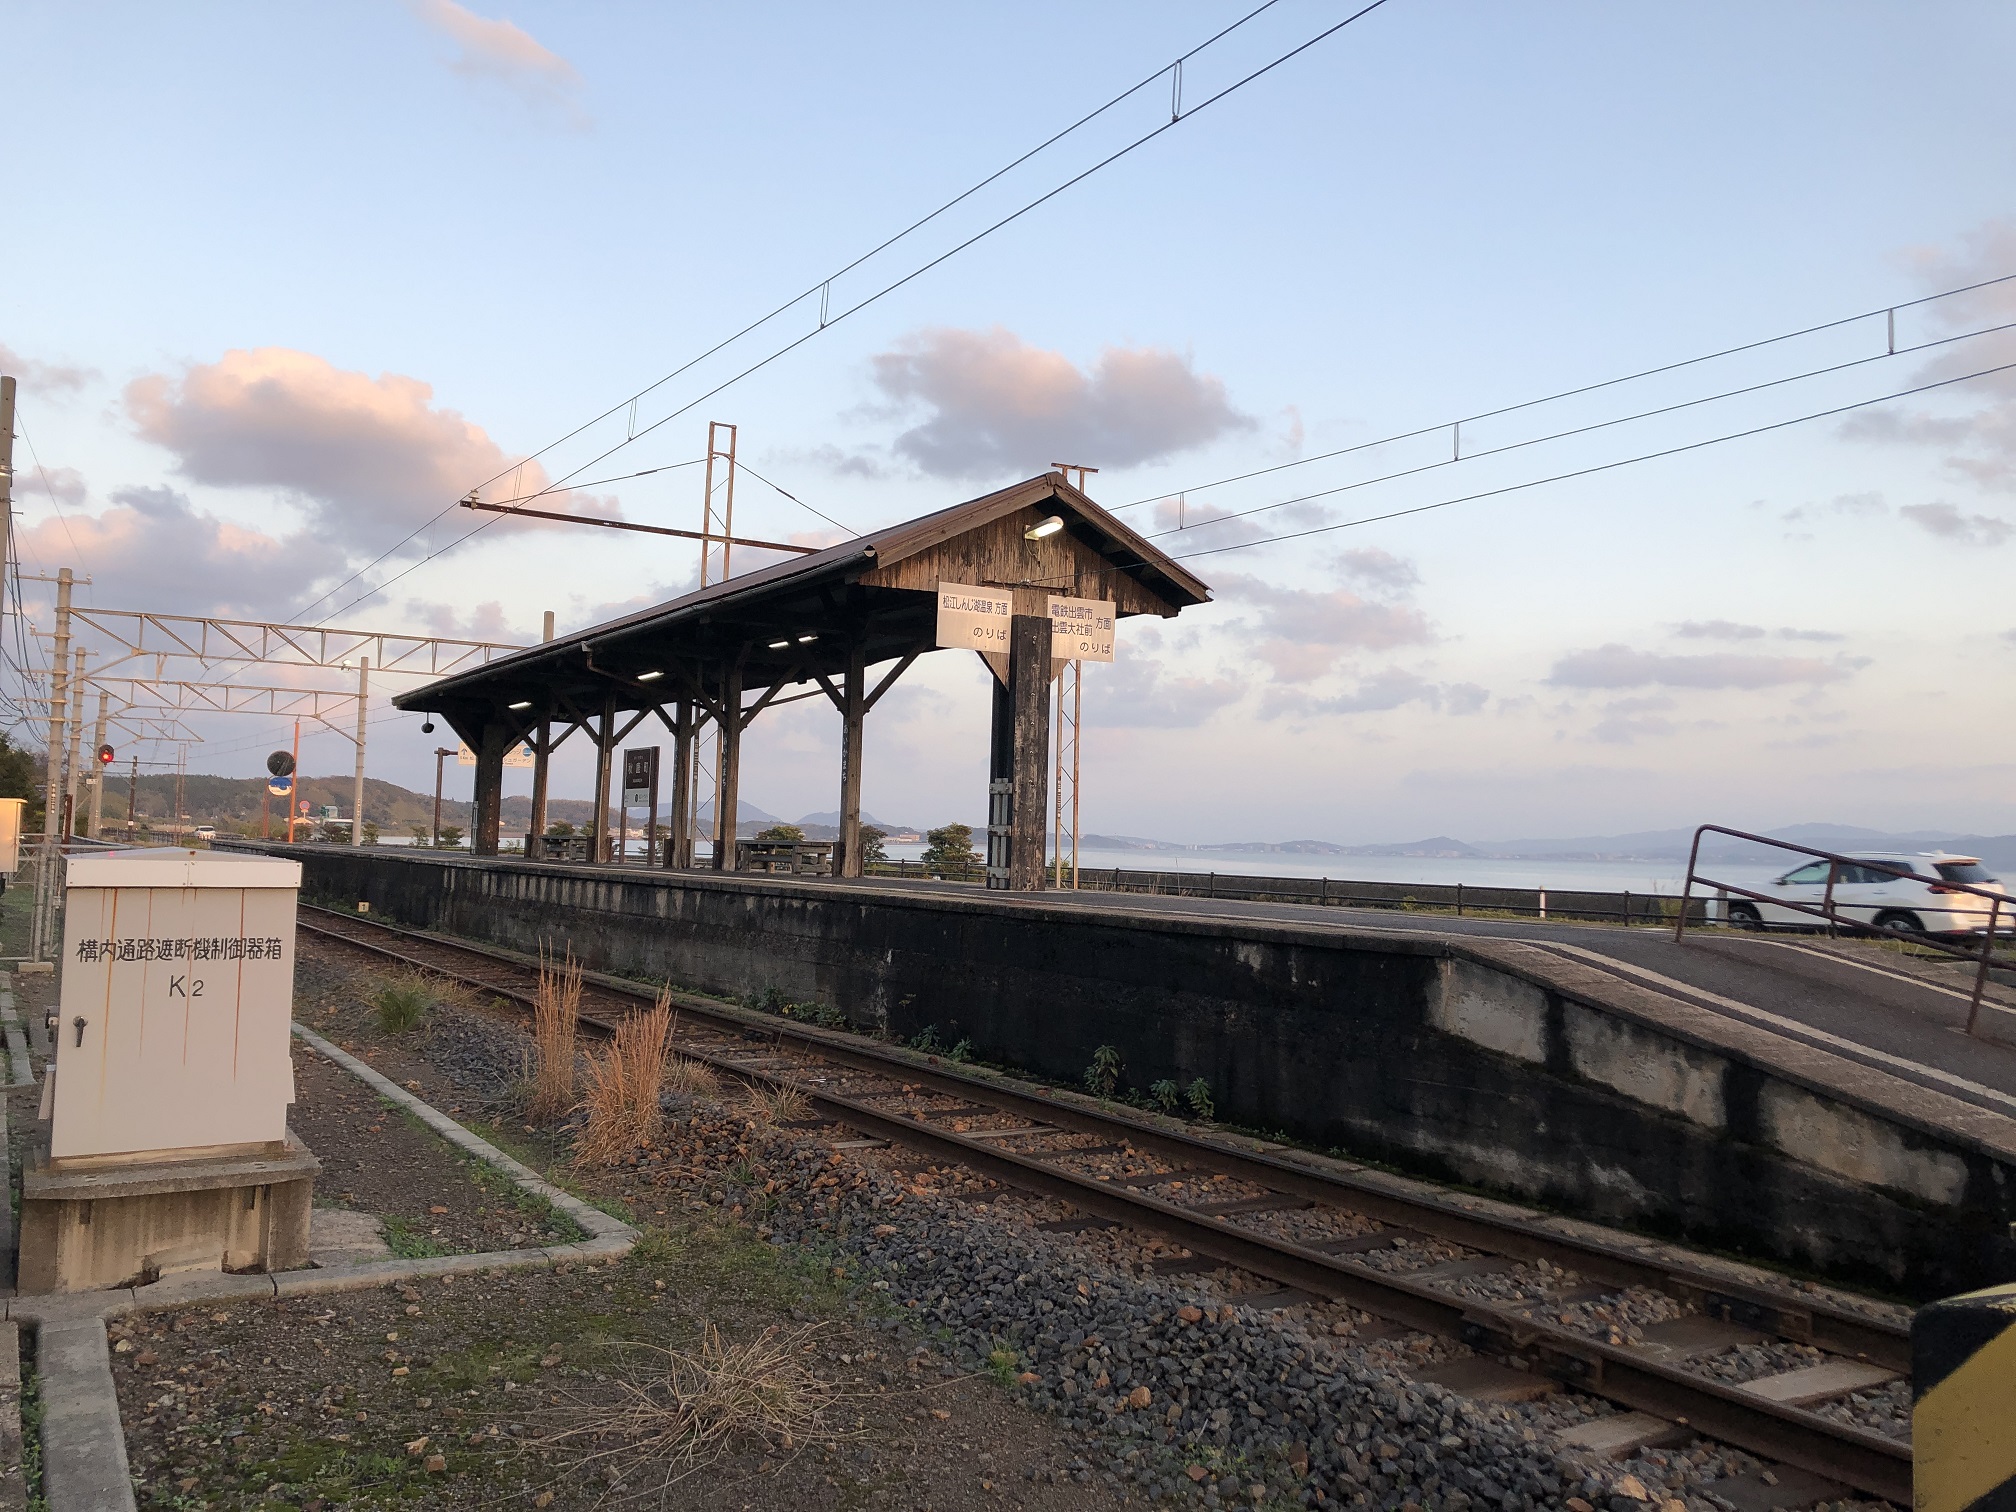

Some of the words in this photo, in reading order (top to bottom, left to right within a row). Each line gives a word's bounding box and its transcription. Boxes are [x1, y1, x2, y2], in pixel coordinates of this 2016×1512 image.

[943, 595, 993, 614] 松江しんじ湖温泉
[995, 602, 1008, 615] 方面
[1051, 604, 1093, 620] 電鉄出雲市
[1052, 620, 1093, 636] 出雲大社前
[1095, 617, 1112, 630] 方面
[973, 627, 1007, 641] のりば
[1080, 642, 1111, 655] のりば
[76, 937, 282, 963] 構内通路遮断機制御器箱
